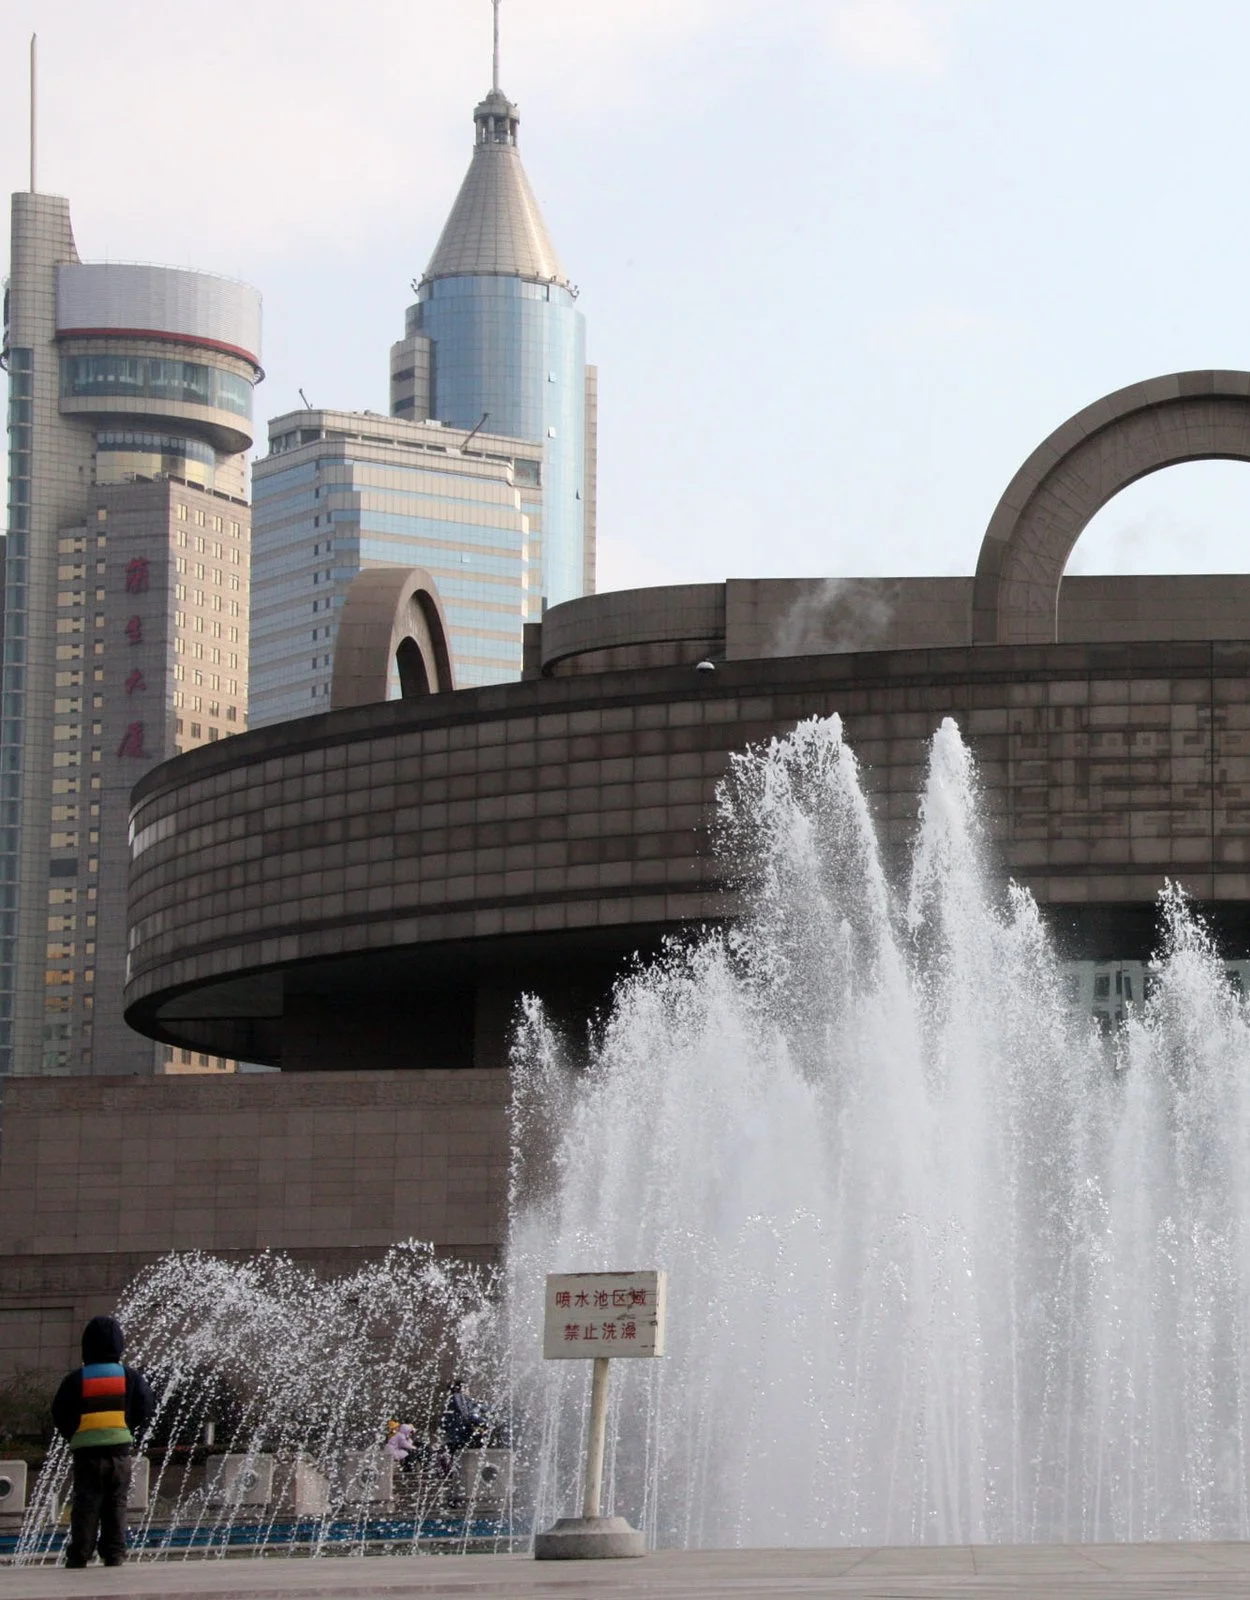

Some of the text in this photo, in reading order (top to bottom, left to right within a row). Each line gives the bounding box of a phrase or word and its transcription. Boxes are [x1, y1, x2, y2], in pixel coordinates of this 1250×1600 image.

[555, 1288, 647, 1309] 喷水池区域
[564, 1321, 637, 1341] 禁止洗澡
